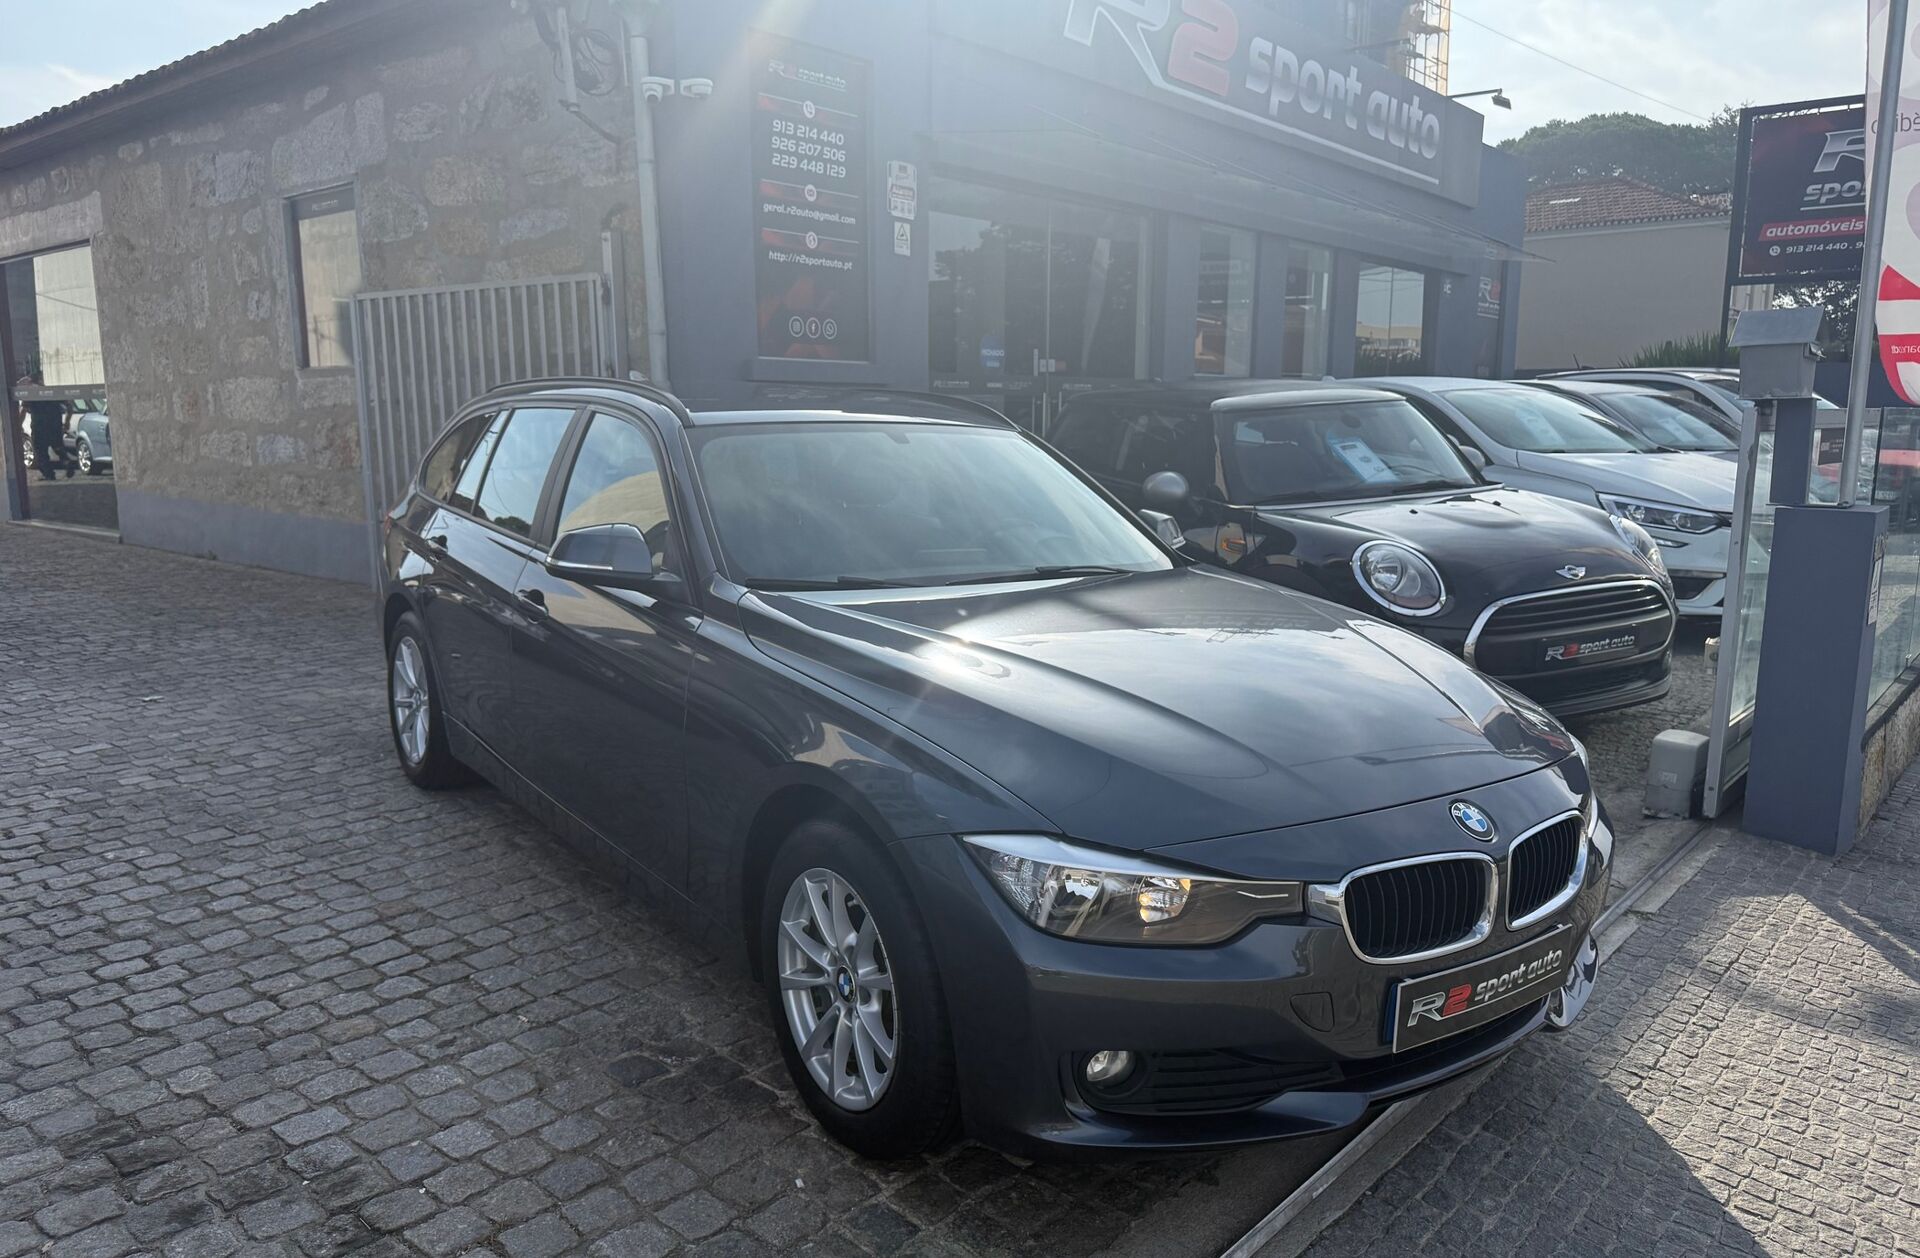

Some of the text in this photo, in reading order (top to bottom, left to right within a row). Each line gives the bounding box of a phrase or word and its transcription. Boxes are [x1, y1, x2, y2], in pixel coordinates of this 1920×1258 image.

[1245, 36, 1363, 130] sport
[1366, 94, 1441, 160] auto
[772, 119, 845, 146] 913 214 440
[771, 136, 846, 162] 926 207 506
[772, 153, 846, 178] 229 448 129
[763, 203, 856, 224] geral.r2auto@gmail.com
[1766, 218, 1864, 237] automóveis
[768, 250, 852, 270] http://r2sportauto.pt
[1786, 245, 1804, 254] 913
[1825, 241, 1848, 251] 440
[1545, 635, 1635, 661] R2 sport auto
[1407, 948, 1563, 1028] R2 sport auto
